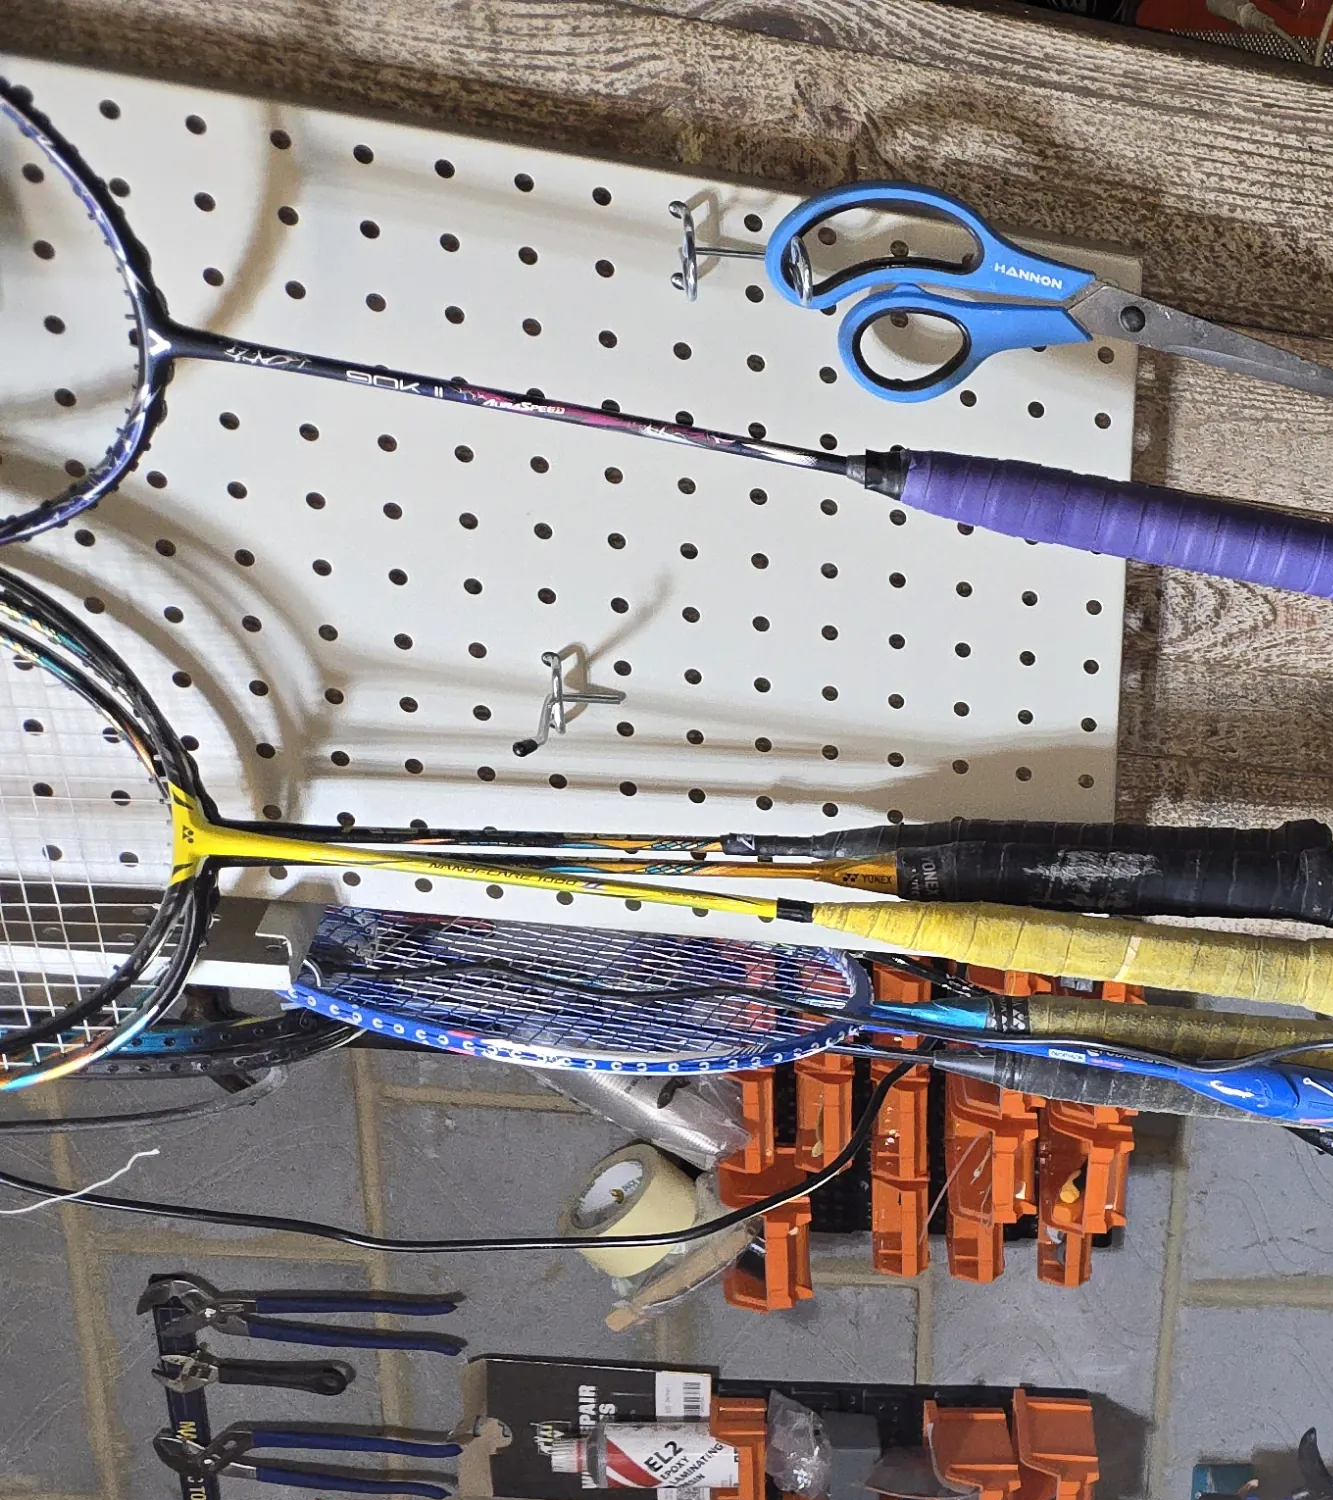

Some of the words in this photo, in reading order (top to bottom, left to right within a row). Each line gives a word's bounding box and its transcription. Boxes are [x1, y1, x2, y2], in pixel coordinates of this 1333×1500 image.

[993, 262, 1063, 290] HANNON
[861, 874, 893, 885] YONEX
[643, 1439, 684, 1472] EL2
[659, 1455, 690, 1479] EPOXY
[669, 1441, 725, 1484] LAMINATING
